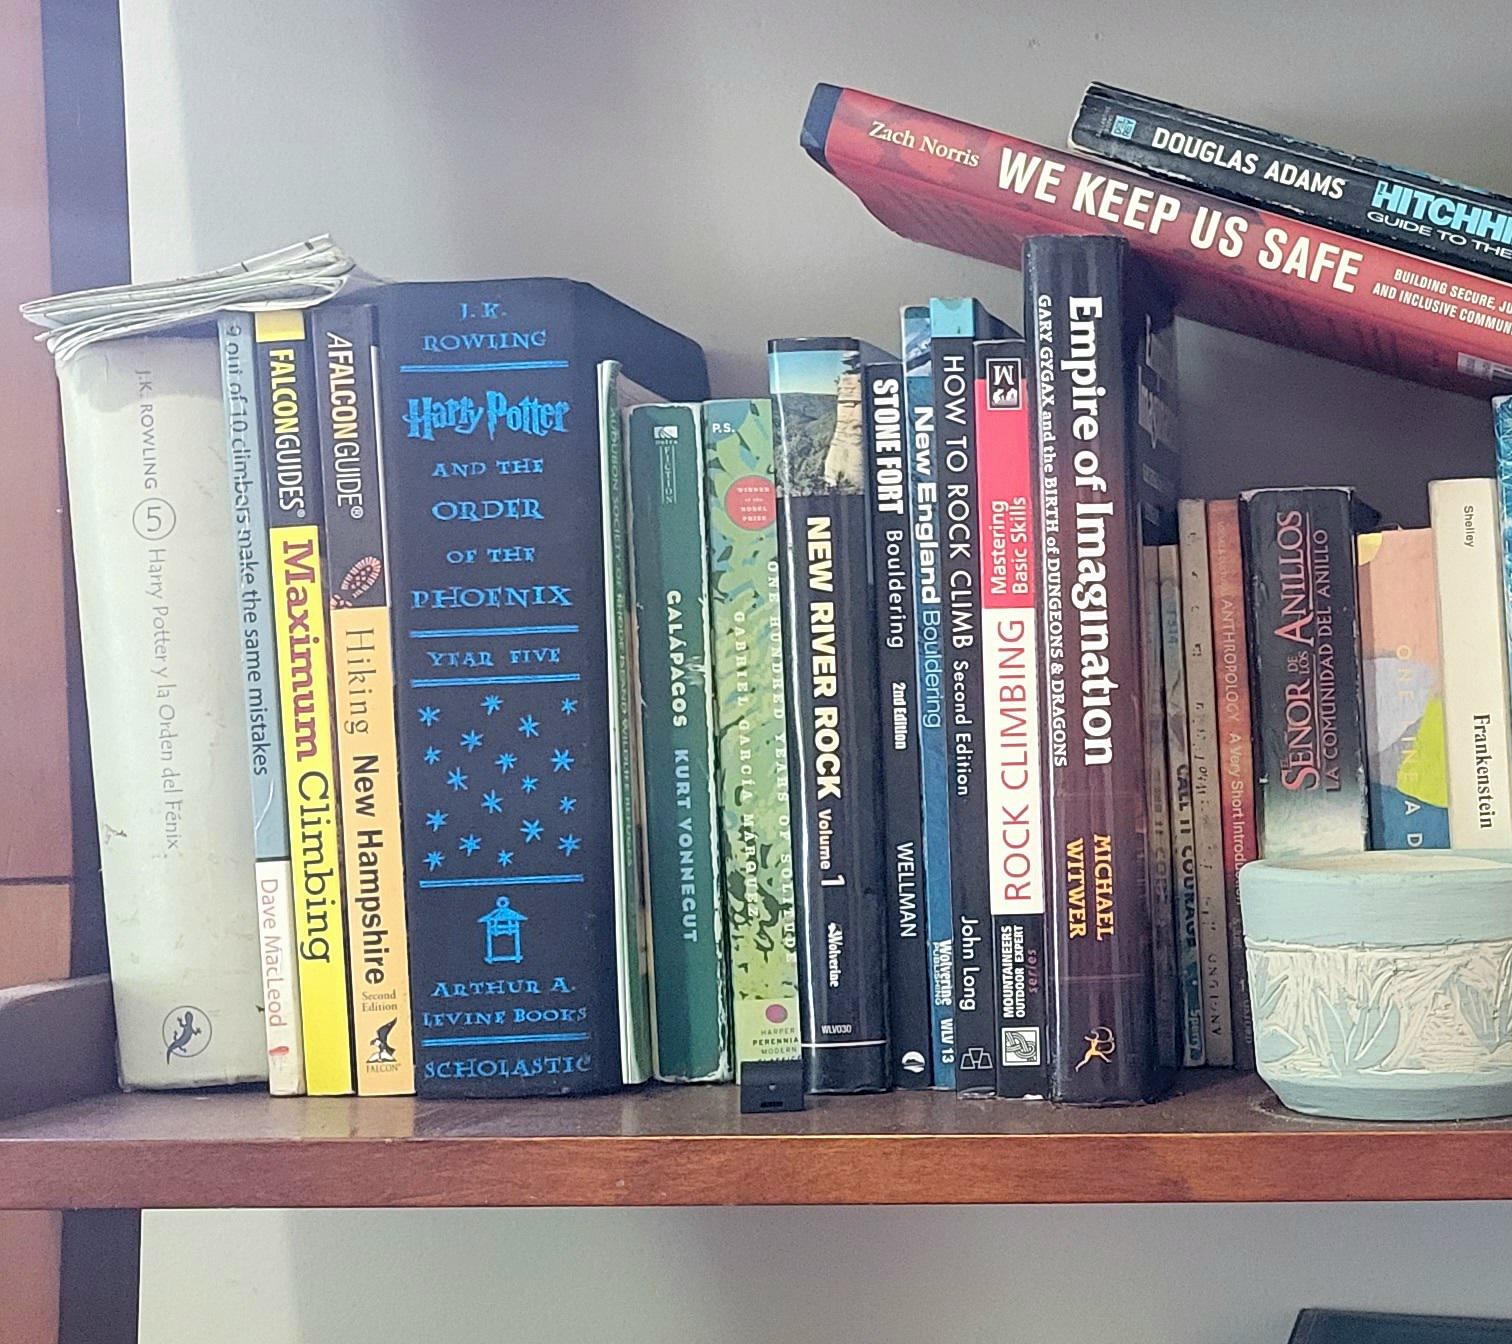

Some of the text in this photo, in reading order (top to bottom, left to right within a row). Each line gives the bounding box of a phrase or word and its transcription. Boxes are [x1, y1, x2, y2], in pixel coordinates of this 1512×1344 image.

[868, 120, 1363, 292] Zach Norris WE KEEP US SAFE
[1151, 128, 1345, 198] DOUGLAS ADAMS
[282, 539, 335, 962] Maximum Climbing
[344, 628, 391, 984] Hiking New Hampshire
[806, 516, 845, 888] NEW RIVER ROCK Volume 1
[872, 379, 918, 937] STONE FORT Bouldering WELLMAN
[943, 355, 982, 1011] HOW TO ROCK CLIMB John Long
[1462, 505, 1496, 828] Shelley Frankenstein
[259, 877, 287, 1027] Dave MacLeod
[1066, 838, 1089, 938] WITWER
[1092, 835, 1114, 939] MICHAEL
